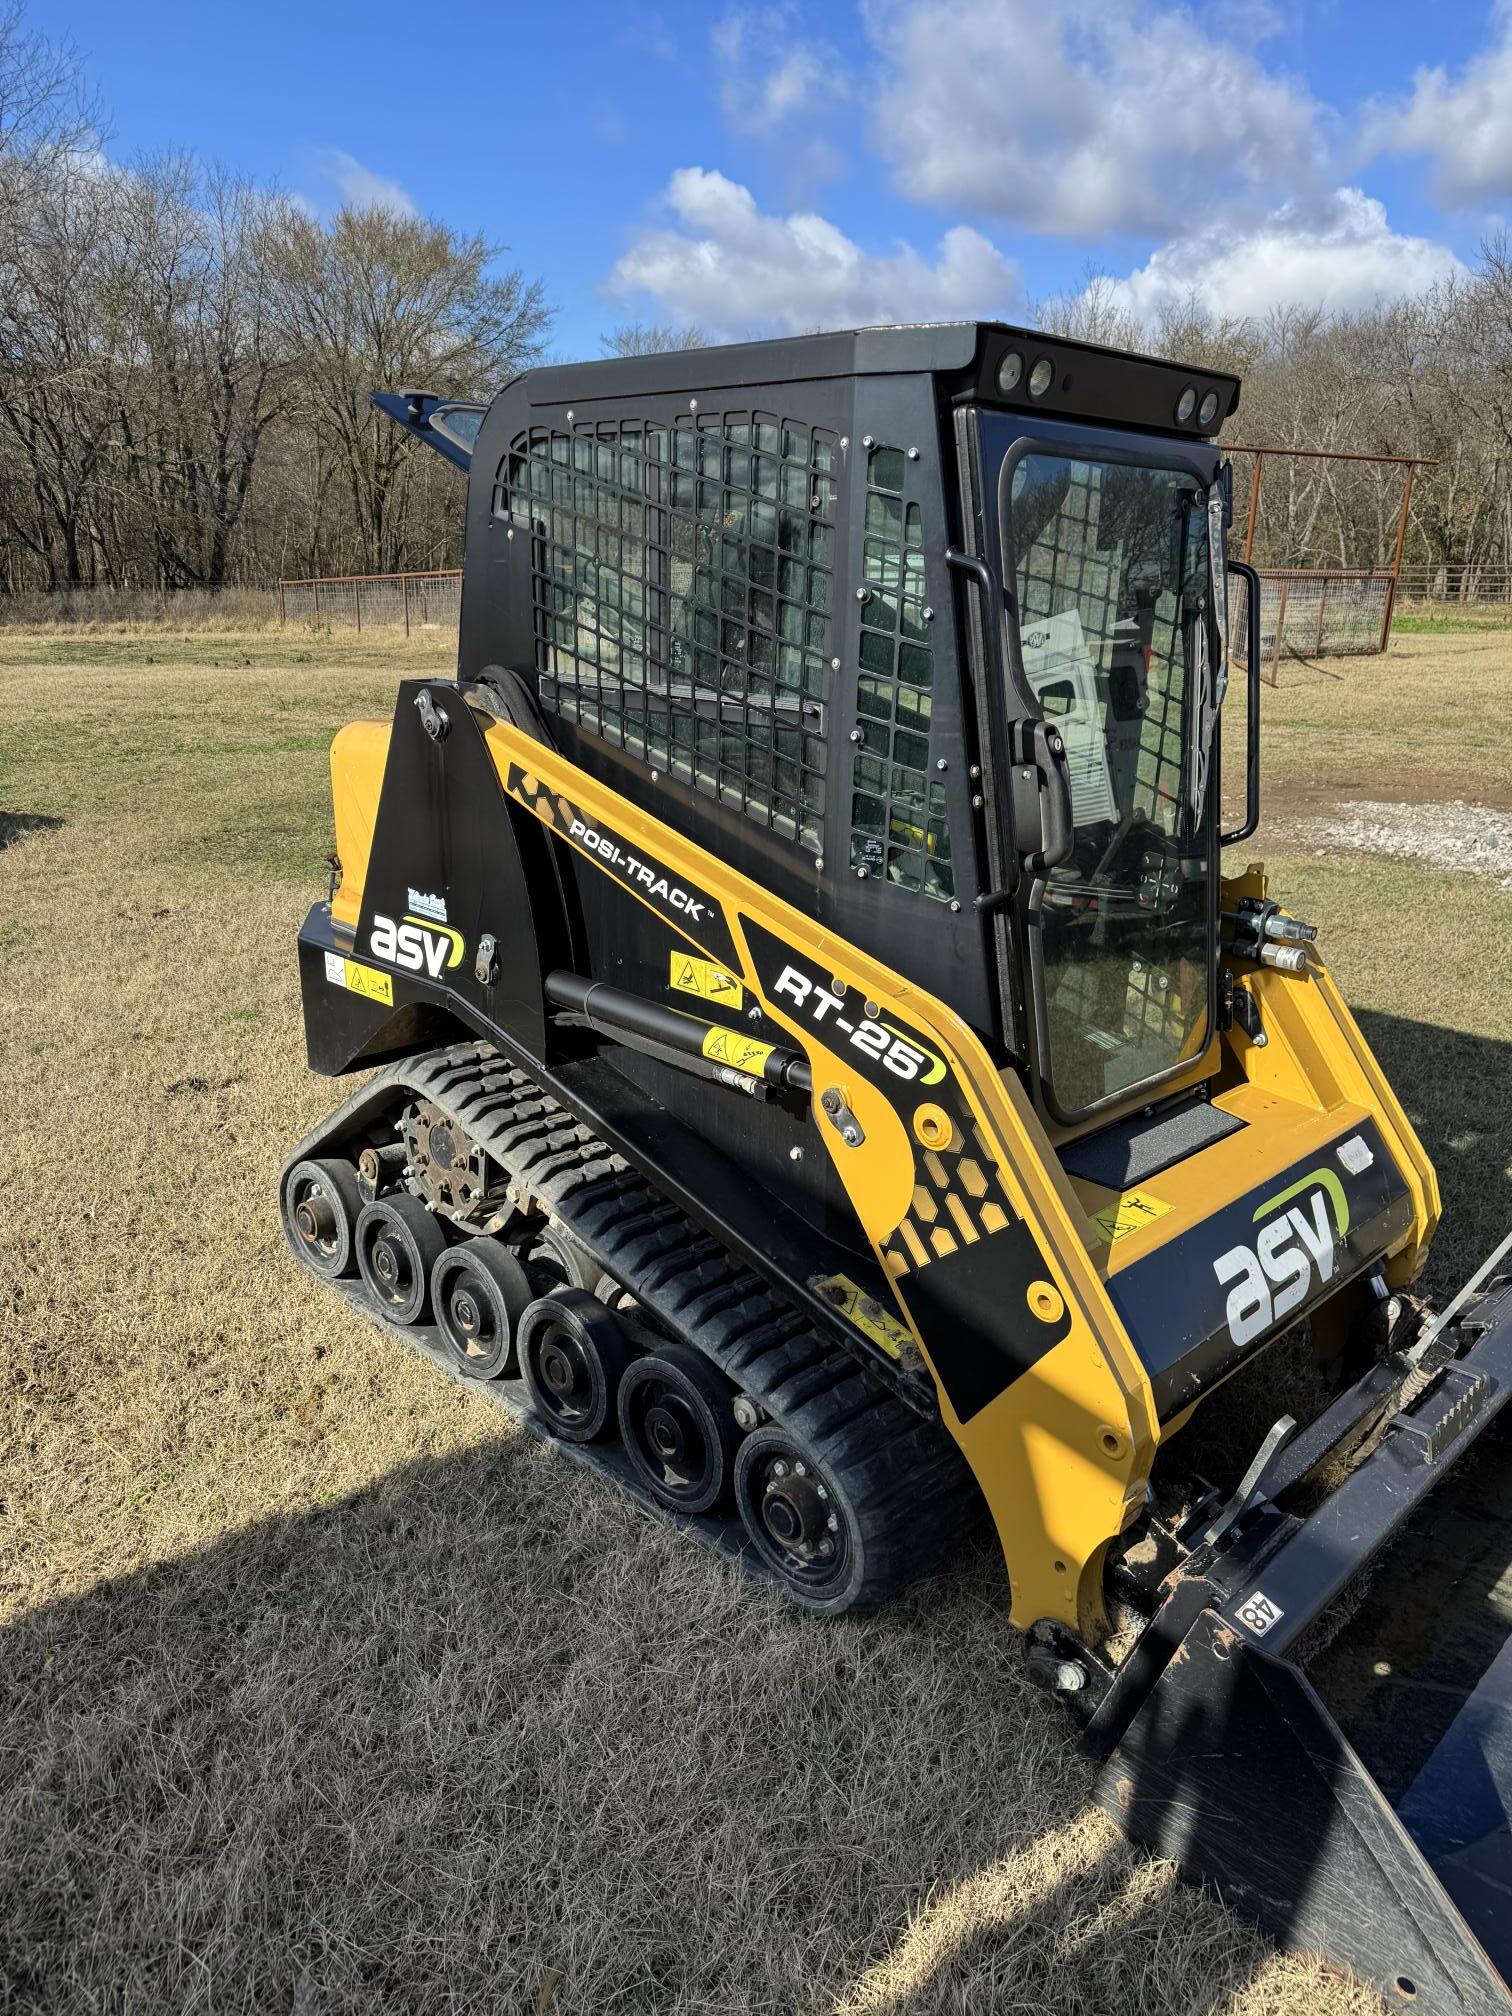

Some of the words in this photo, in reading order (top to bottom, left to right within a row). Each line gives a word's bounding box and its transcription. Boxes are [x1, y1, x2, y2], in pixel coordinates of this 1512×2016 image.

[569, 818, 706, 922] POSI-TRACK
[773, 964, 926, 1080] RT-25
[1242, 1598, 1275, 1630] 48
